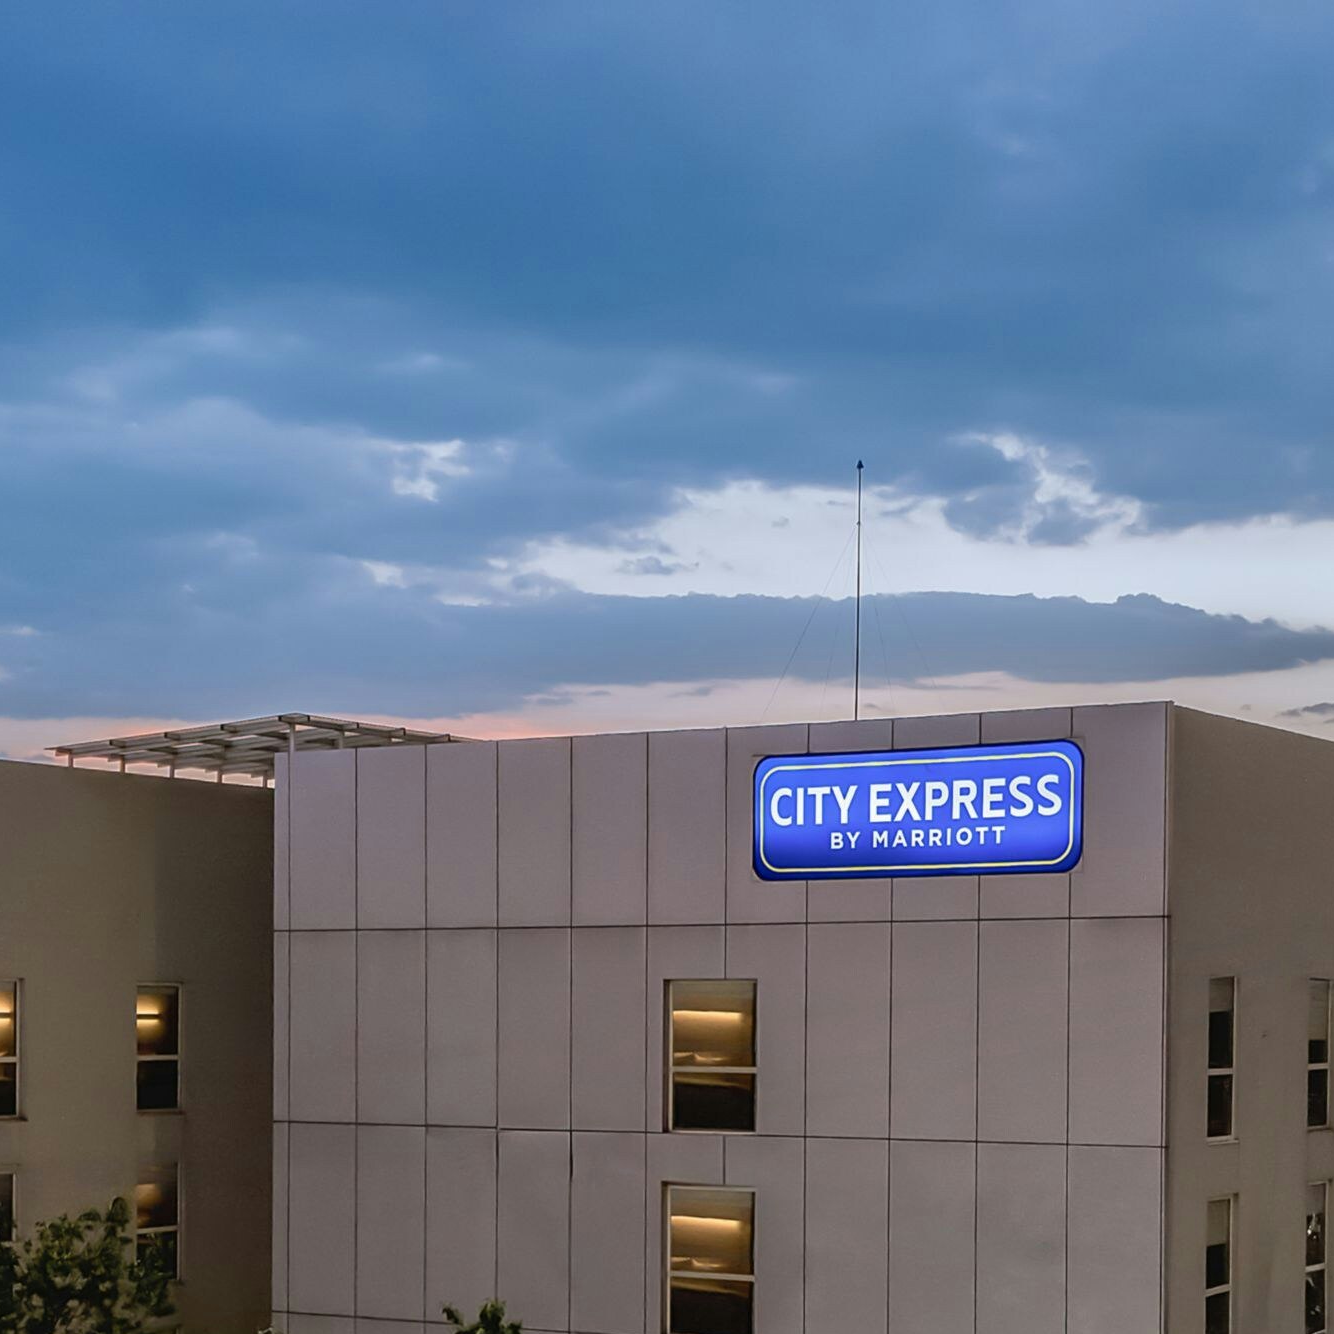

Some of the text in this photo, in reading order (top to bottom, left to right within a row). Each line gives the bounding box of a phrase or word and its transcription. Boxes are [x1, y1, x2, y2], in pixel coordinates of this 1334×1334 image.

[770, 774, 1063, 826] CITY EXPRESS
[830, 825, 1006, 850] BY MARRIOTT
